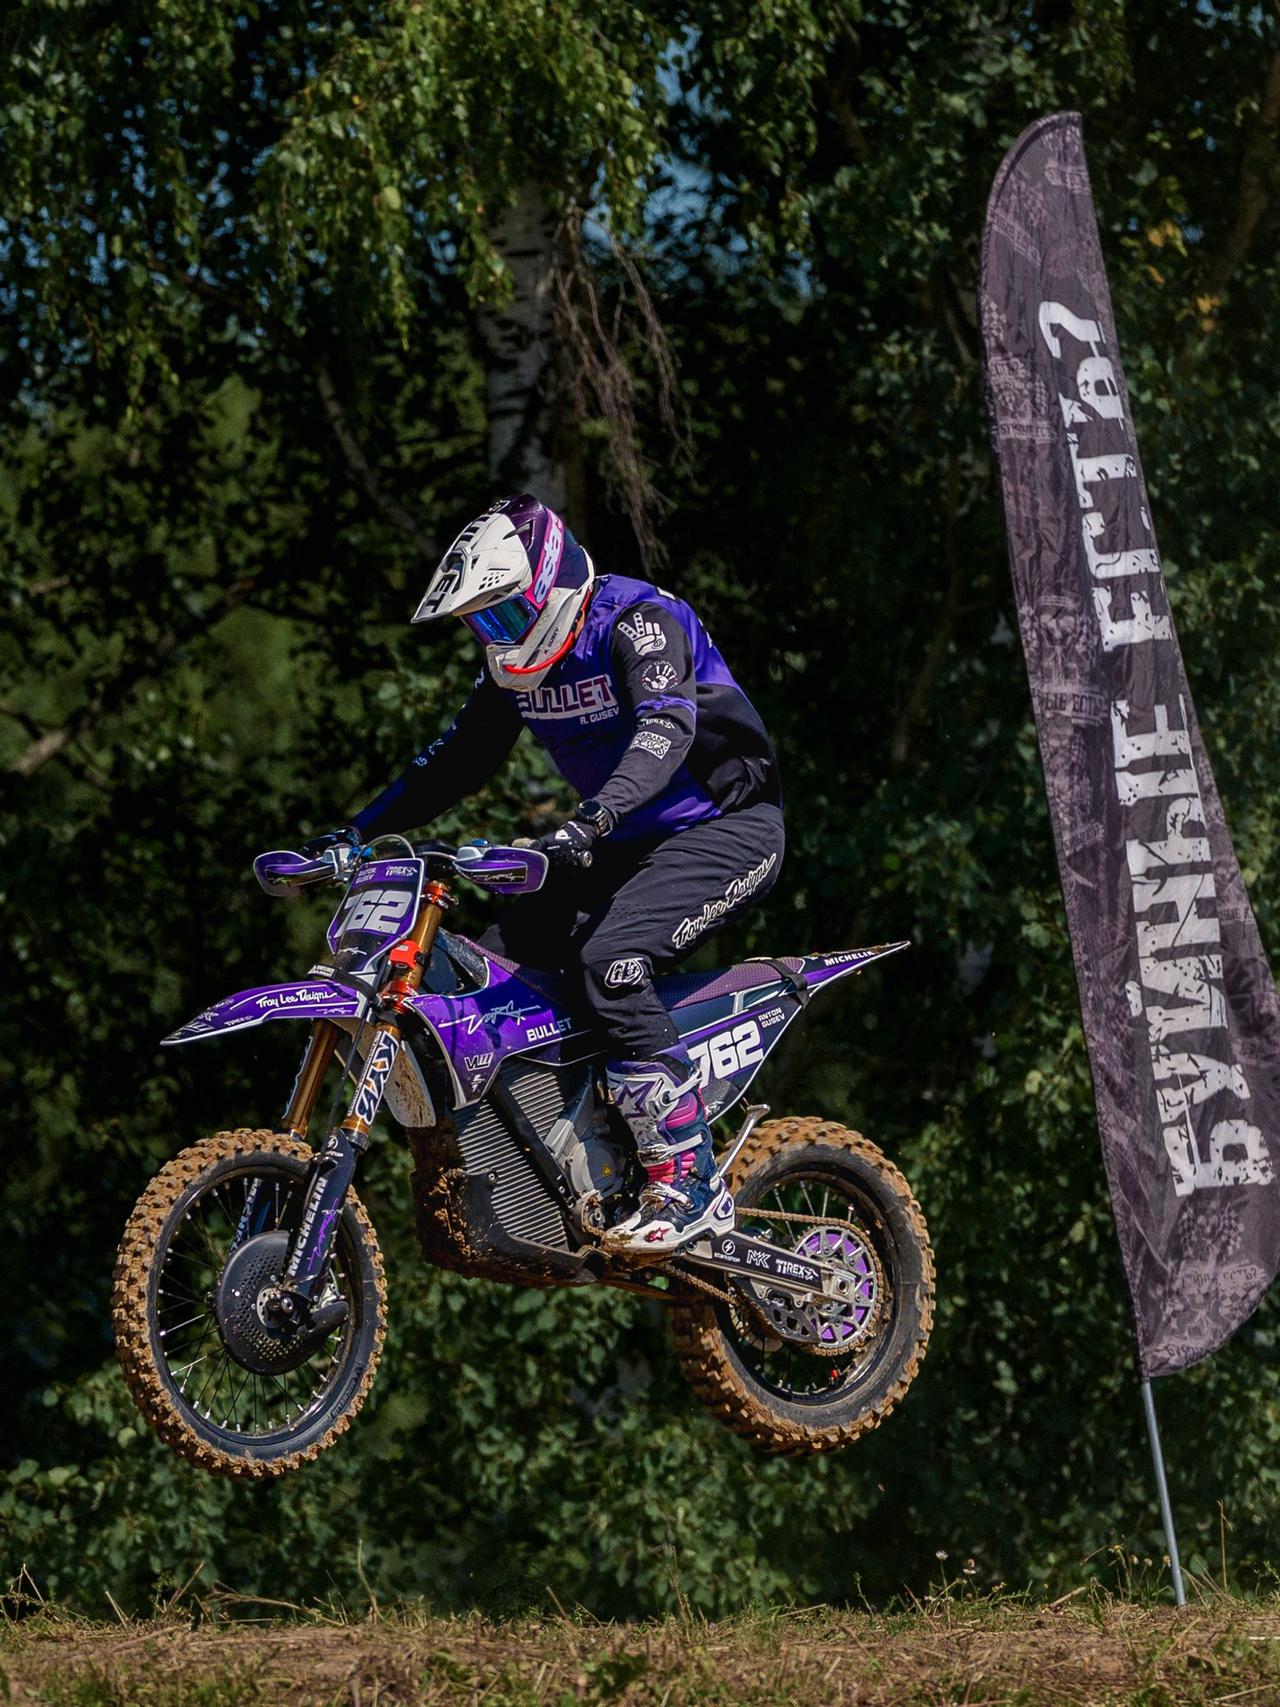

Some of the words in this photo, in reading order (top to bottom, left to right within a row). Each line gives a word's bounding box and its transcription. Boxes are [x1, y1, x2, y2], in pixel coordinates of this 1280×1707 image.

[1039, 301, 1173, 652] ЕСТЬ?
[516, 674, 618, 719] BULLET
[590, 706, 620, 723] GUSEV
[333, 890, 412, 938] 762
[672, 917, 702, 949] Troy
[701, 900, 727, 928] Lee
[725, 853, 777, 908] Designs
[1110, 695, 1276, 1197] БУЙНЫЕ
[255, 996, 278, 1008] Troy
[280, 993, 298, 1004] Lee
[296, 989, 338, 1002] Designs
[758, 1006, 782, 1021] ANTON
[761, 1013, 785, 1028] GUSEV
[526, 1017, 572, 1042] BULLET
[355, 1030, 399, 1125] KYB
[687, 1020, 764, 1089] 762
[287, 1176, 328, 1276] MICHELIN
[776, 1258, 806, 1276] TIREX
